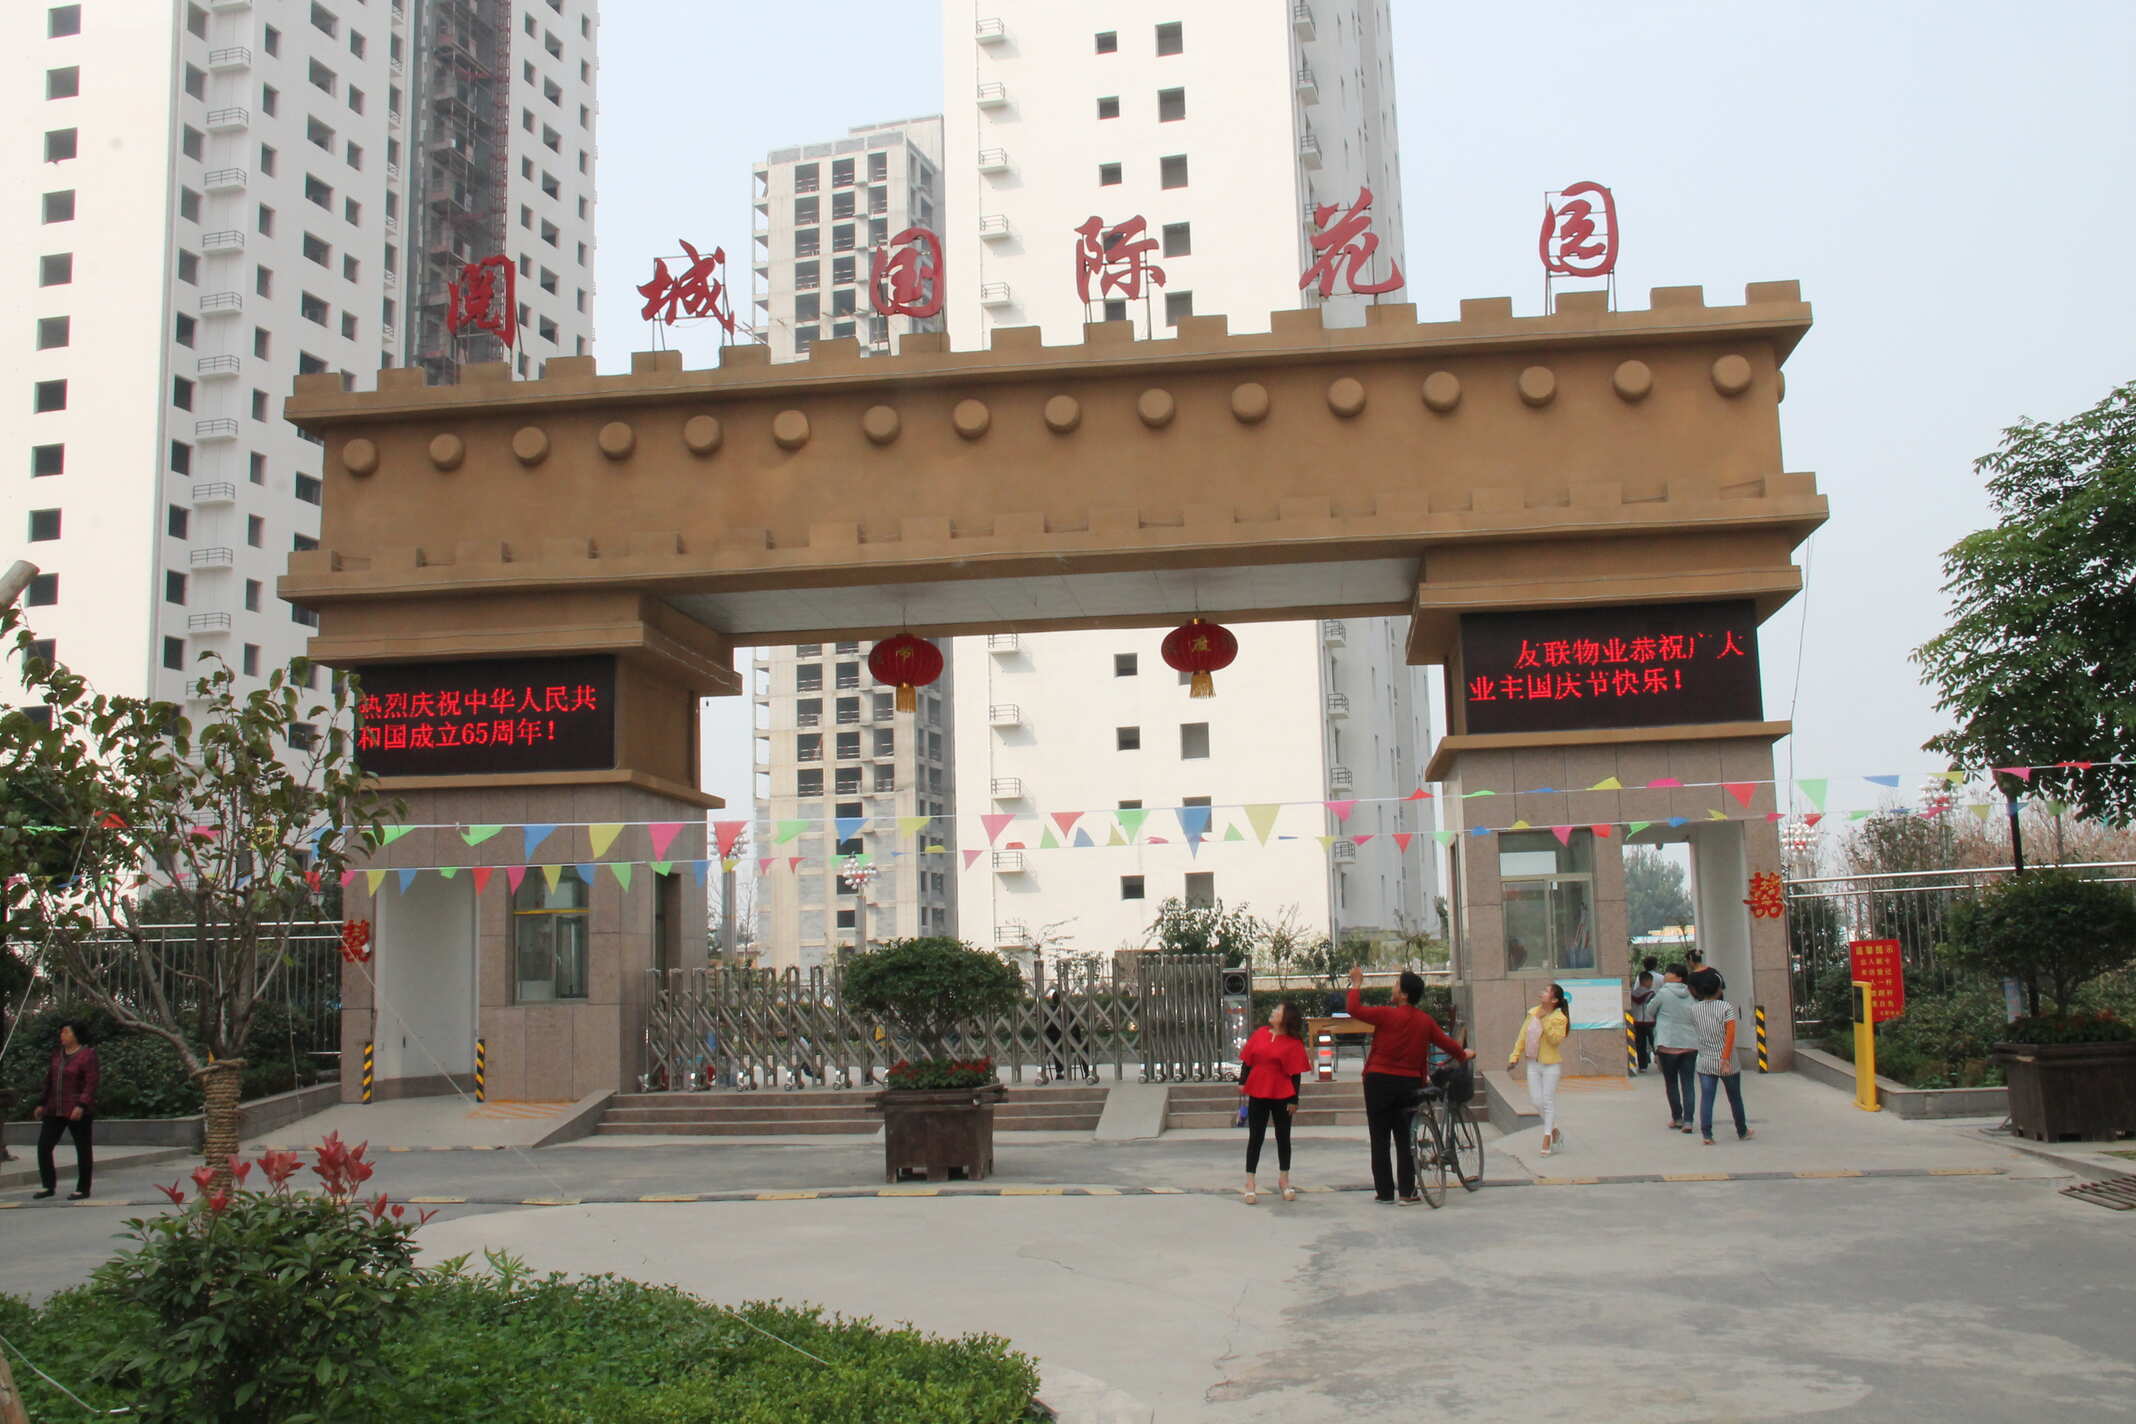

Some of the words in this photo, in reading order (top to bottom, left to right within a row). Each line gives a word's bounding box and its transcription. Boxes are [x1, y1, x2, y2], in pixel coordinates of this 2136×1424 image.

[358, 685, 598, 719] 热烈庆祝中华人民共
[357, 720, 556, 751] 和国成立65周年!
